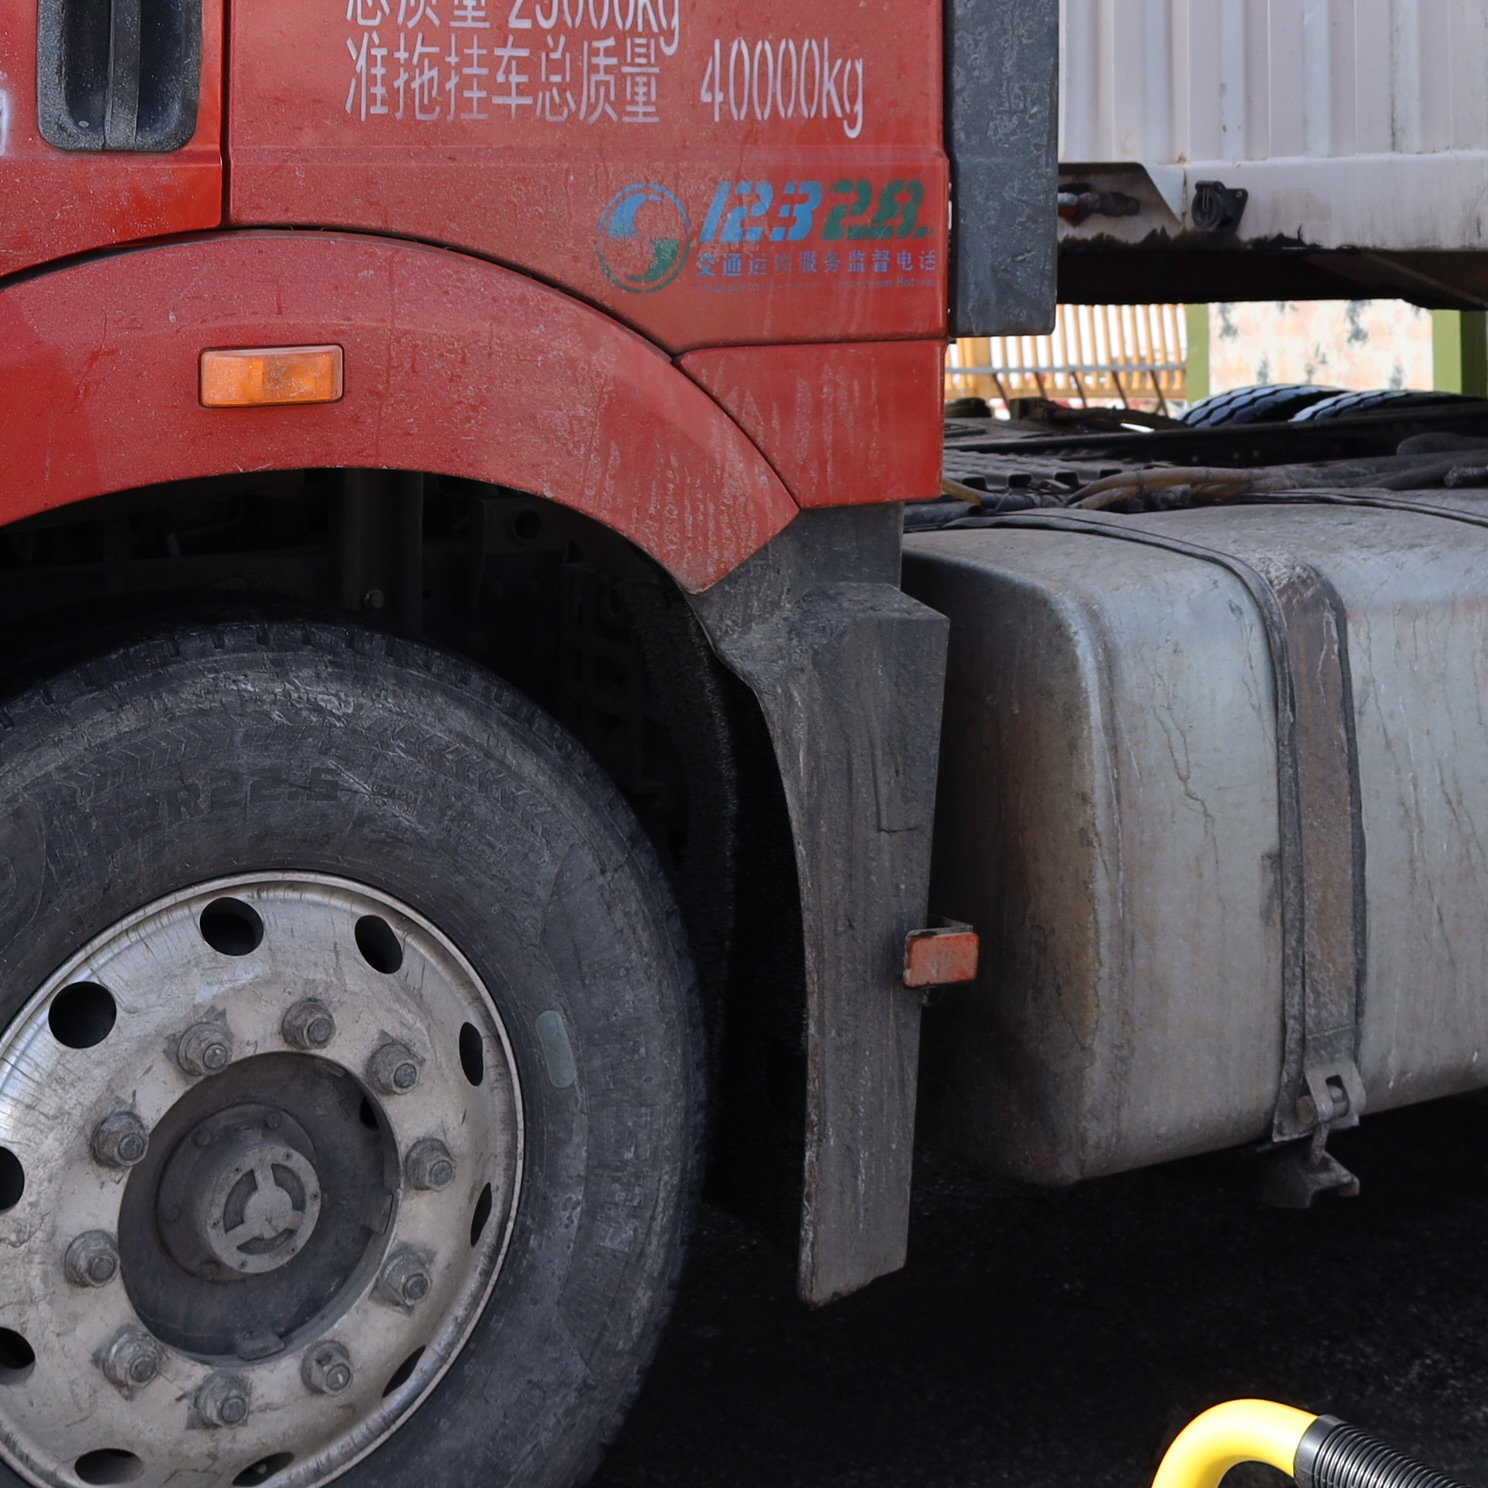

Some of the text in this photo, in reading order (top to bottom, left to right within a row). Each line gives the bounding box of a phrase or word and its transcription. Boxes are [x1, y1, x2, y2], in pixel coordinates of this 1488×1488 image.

[345, 30, 863, 139] 准拖挂车总质量 40000kg
[699, 179, 929, 244] 12328
